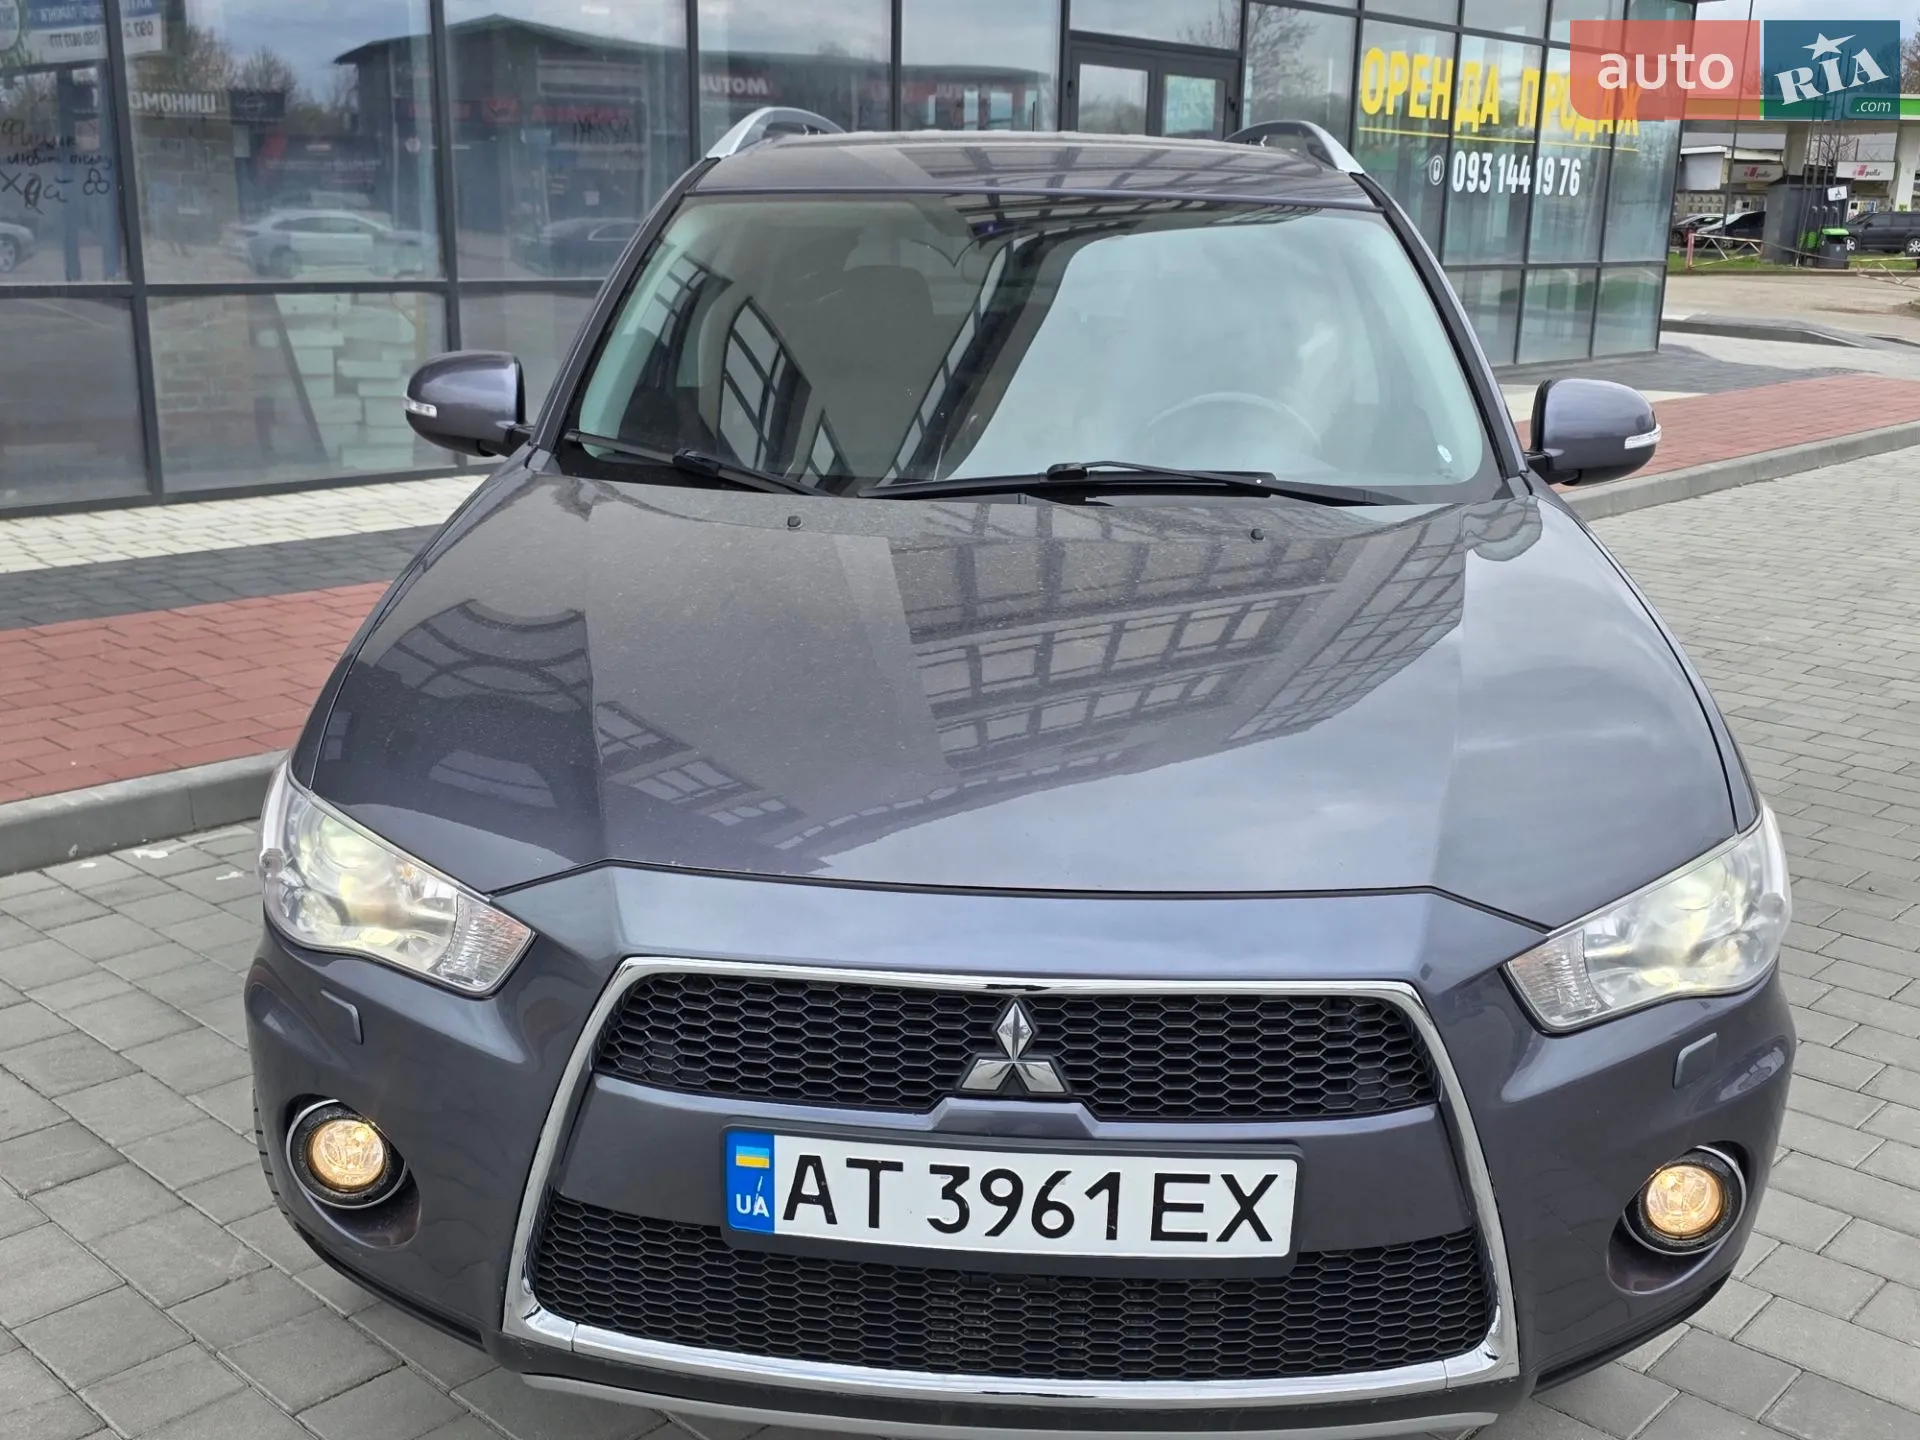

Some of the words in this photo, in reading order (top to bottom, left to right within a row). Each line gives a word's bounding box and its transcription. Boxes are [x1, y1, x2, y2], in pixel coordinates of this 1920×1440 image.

[1361, 47, 1499, 133] ОРЕНДА
[1518, 69, 1640, 141] ПРОДАЖ
[1452, 151, 1493, 193] 093
[1498, 154, 1531, 194] 144
[1535, 157, 1556, 195] 19
[1560, 158, 1581, 196] 76
[735, 1193, 770, 1218] UA
[783, 1154, 904, 1230] AT
[926, 1164, 1122, 1242] 3961
[1150, 1172, 1279, 1244] EX
